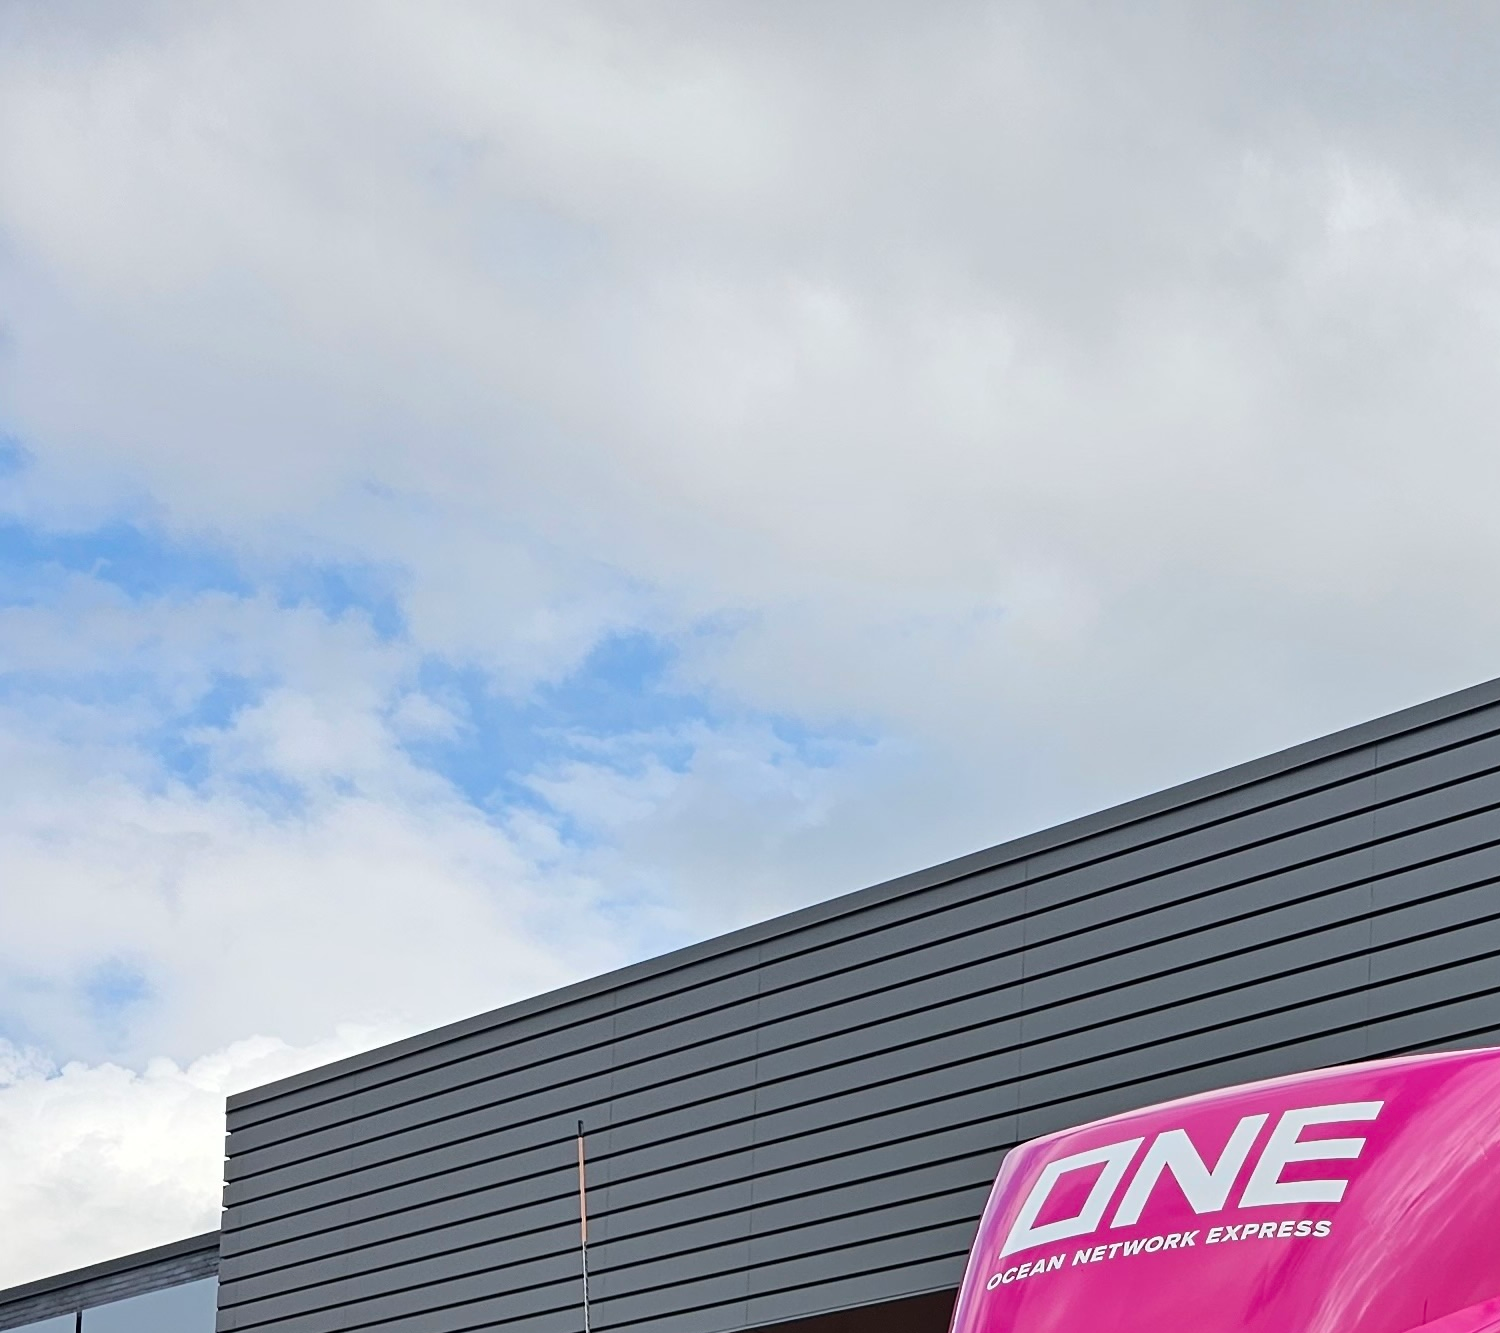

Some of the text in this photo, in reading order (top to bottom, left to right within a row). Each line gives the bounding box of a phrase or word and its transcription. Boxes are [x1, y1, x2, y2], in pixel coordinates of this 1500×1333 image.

[999, 1100, 1385, 1259] ONE
[986, 1220, 1332, 1291] OCEAN NETWORK EXPRESS
